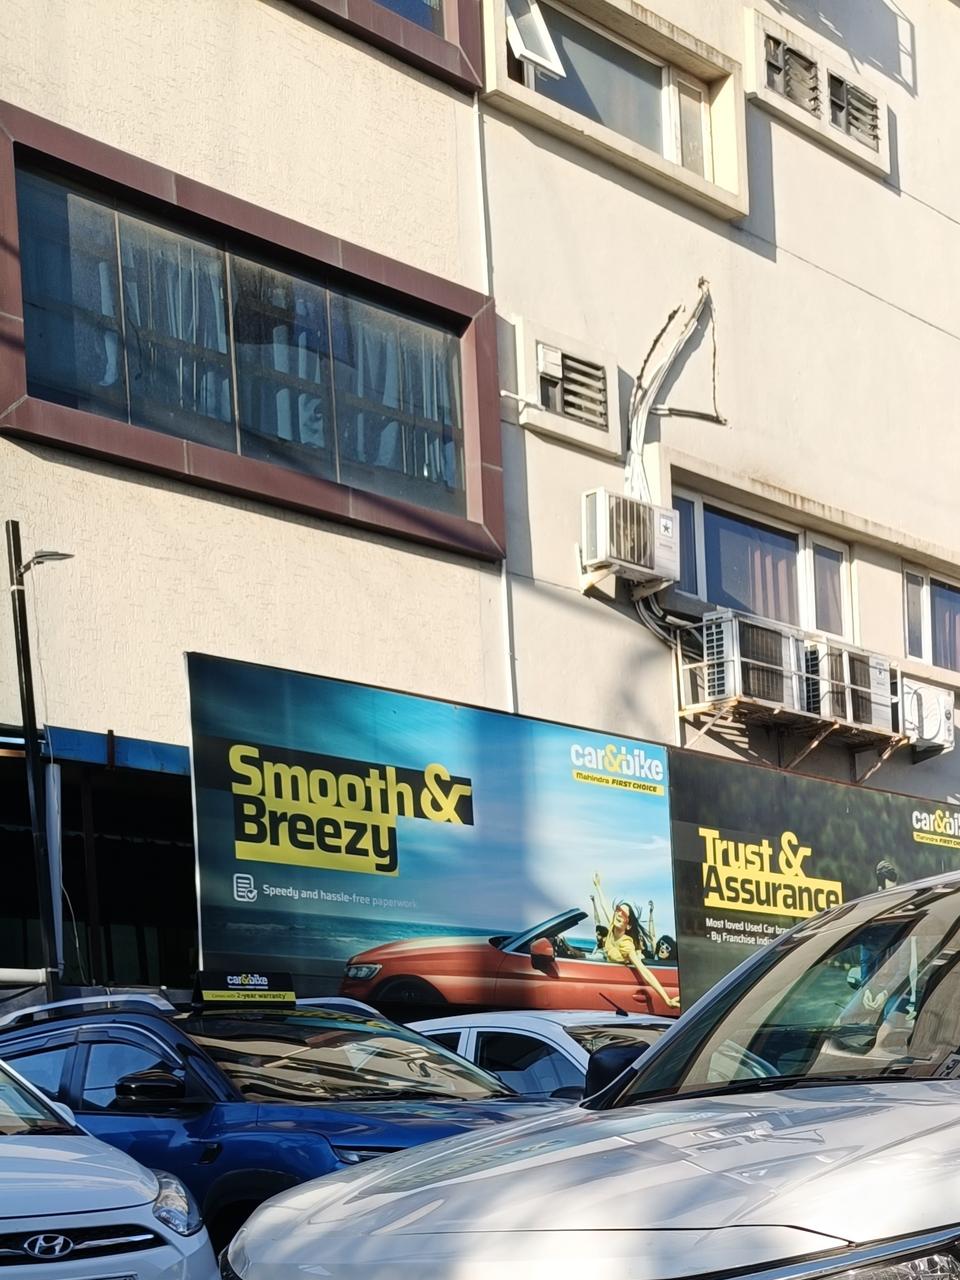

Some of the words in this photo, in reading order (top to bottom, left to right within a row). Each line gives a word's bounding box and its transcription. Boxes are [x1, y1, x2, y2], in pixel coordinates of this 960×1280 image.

[570, 744, 663, 781] car&bike
[229, 745, 414, 817] Smooth
[420, 763, 472, 826] &
[576, 772, 610, 785] Mahindra
[611, 779, 632, 788] FIRST
[633, 782, 657, 793] CHOICE
[233, 794, 398, 873] Breezy
[698, 827, 773, 873] Trust
[778, 831, 812, 878] &
[263, 884, 299, 900] Speedy
[301, 890, 318, 899] and
[320, 890, 371, 905] hassle-free
[703, 865, 840, 913] Assurance
[705, 918, 724, 929] Most
[725, 919, 744, 931] loved
[745, 921, 763, 933] Used
[763, 923, 775, 934] Car
[711, 931, 721, 943] By
[722, 932, 756, 945] Franchise
[227, 973, 269, 985] car&bike
